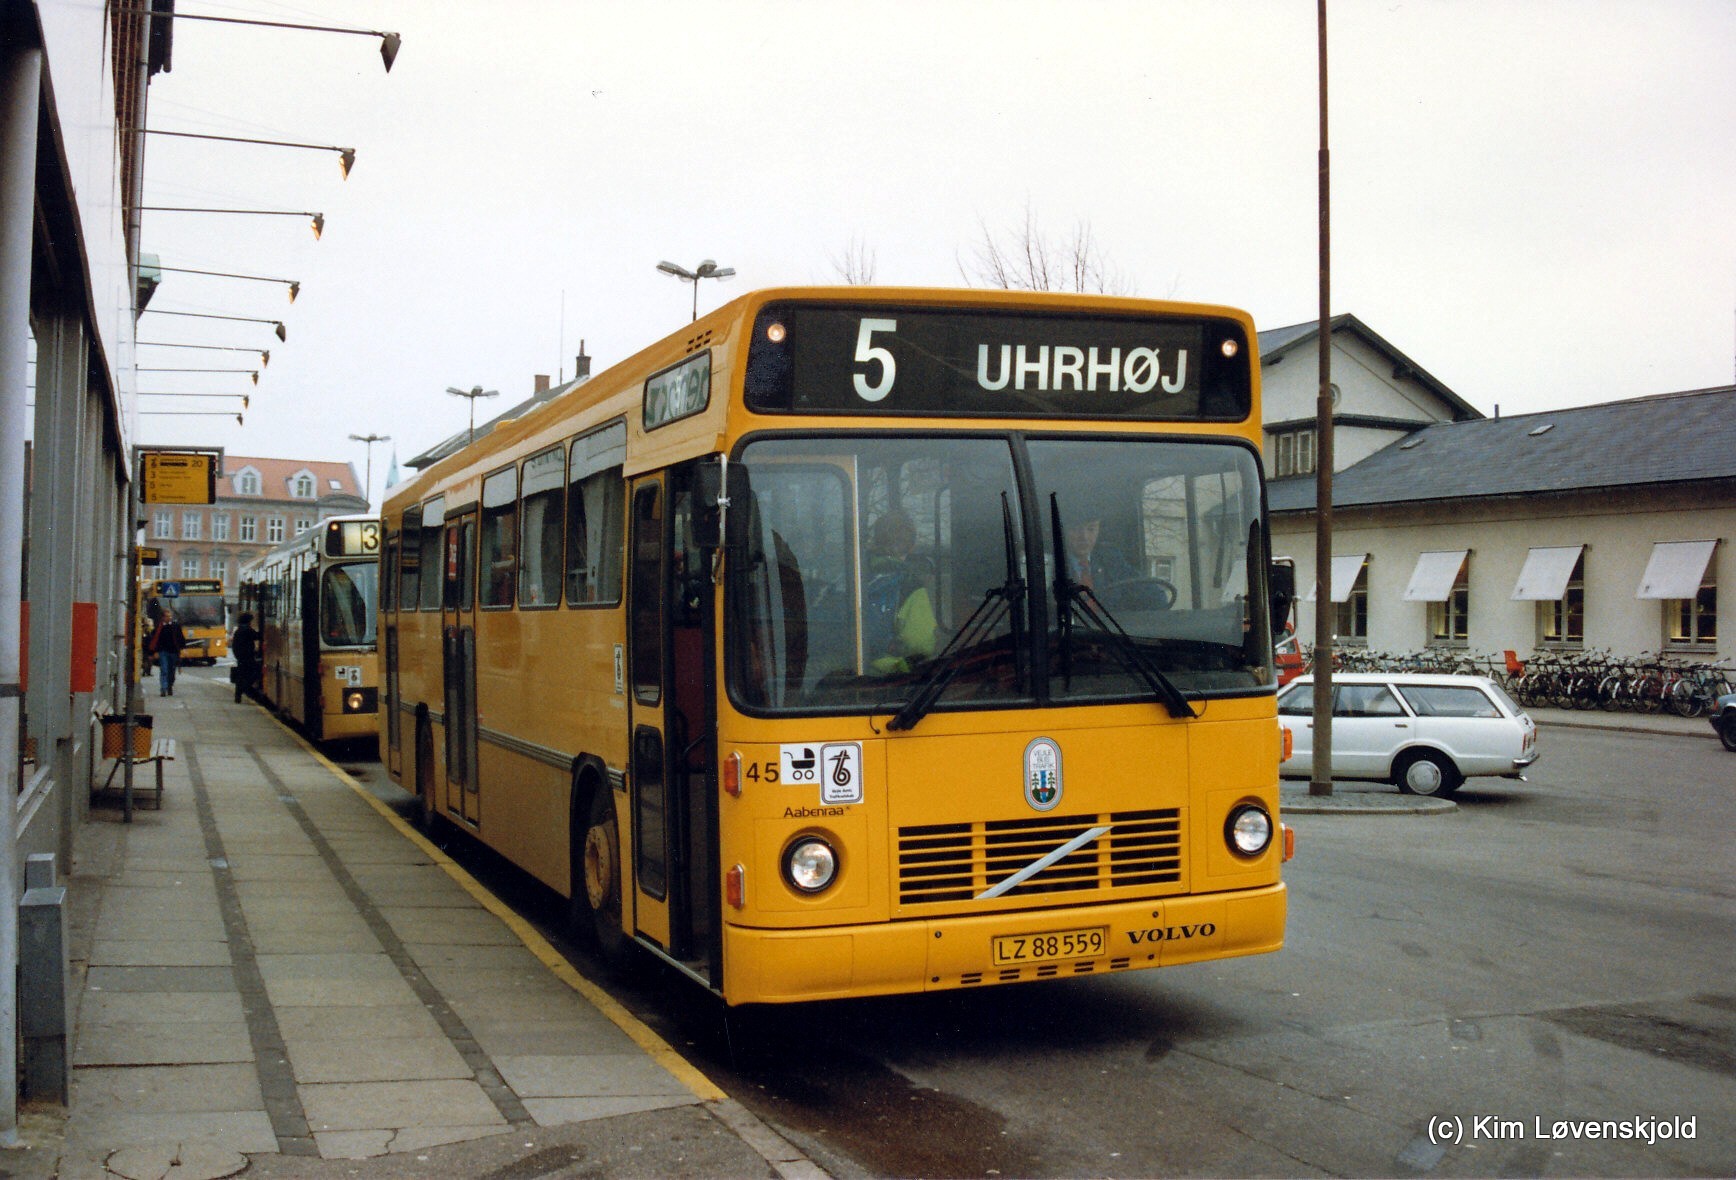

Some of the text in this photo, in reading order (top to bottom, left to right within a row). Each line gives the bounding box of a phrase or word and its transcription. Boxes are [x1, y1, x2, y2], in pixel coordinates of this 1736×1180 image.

[852, 317, 1188, 402] 5 UHRHØJ
[363, 523, 379, 551] 3
[745, 762, 780, 783] 45
[783, 806, 845, 818] Aabenraa
[1125, 923, 1216, 945] VOLVO
